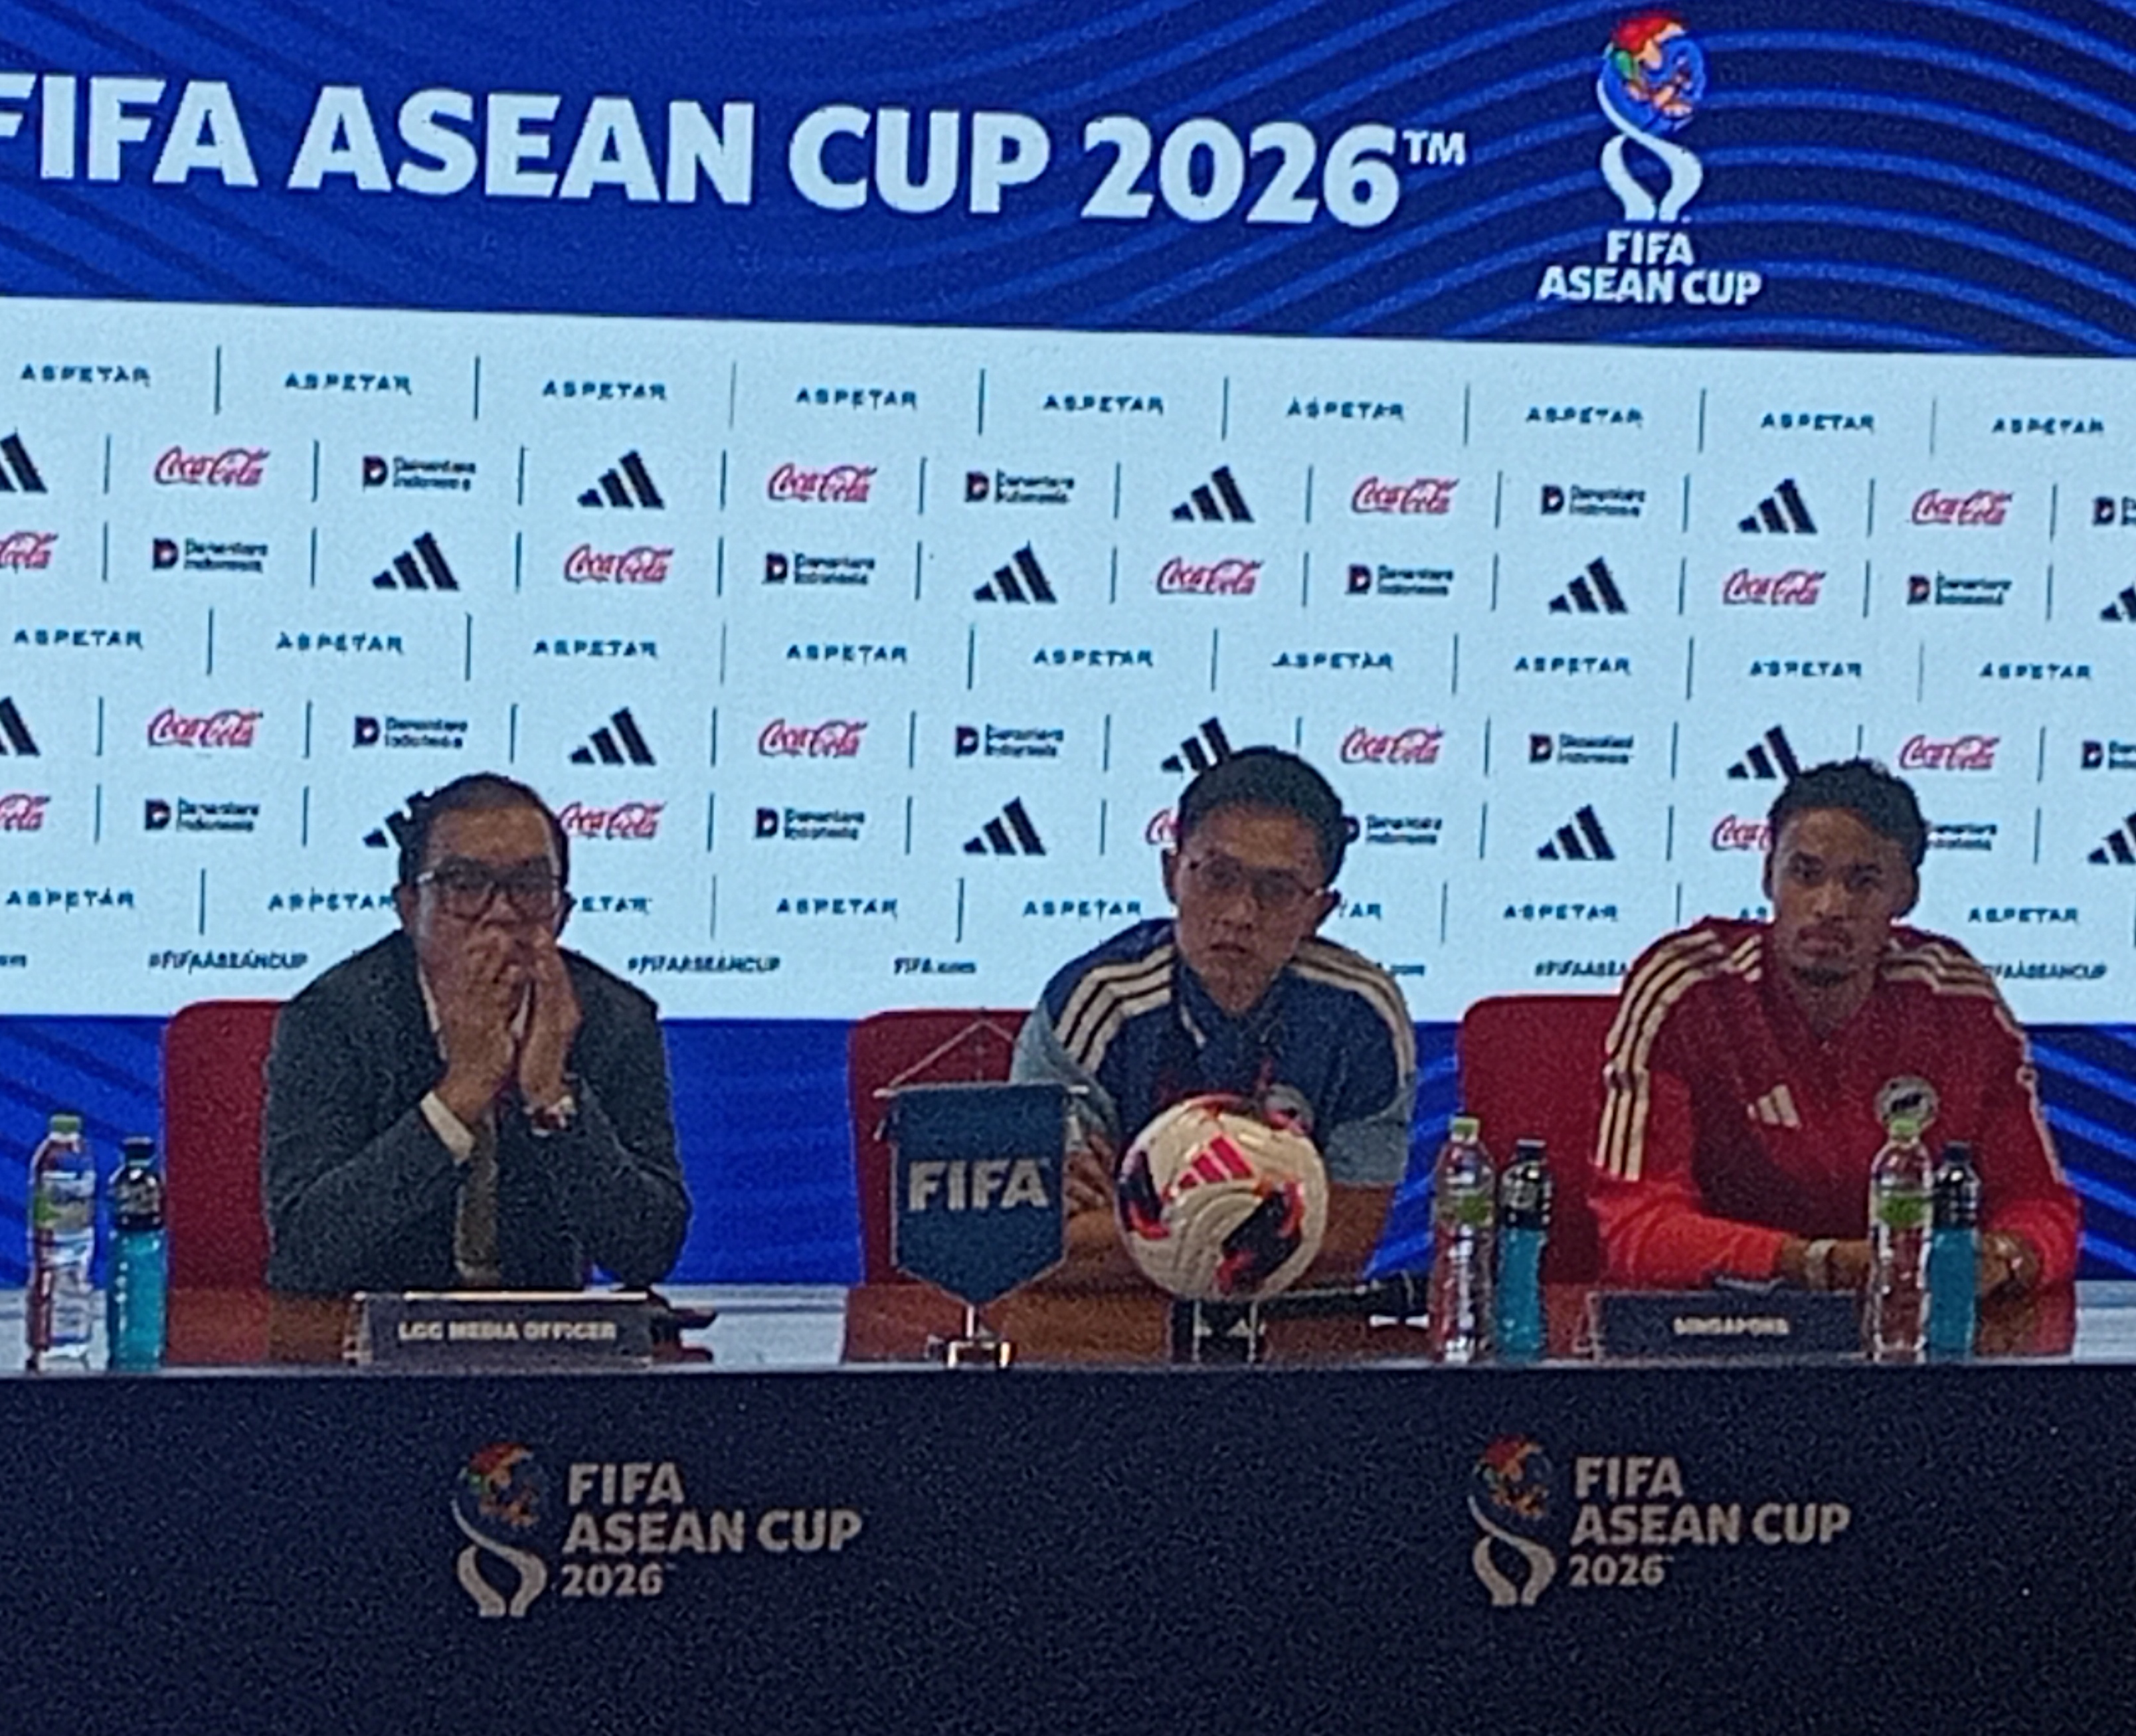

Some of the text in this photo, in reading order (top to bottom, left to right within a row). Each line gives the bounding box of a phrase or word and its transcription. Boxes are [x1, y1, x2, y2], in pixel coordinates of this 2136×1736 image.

[286, 84, 754, 205] ASEAN
[788, 104, 1050, 215] CUP
[1606, 229, 1694, 266] FIFA
[1536, 265, 1762, 305] ASEAN CUP
[581, 895, 652, 914] ETAR
[908, 1158, 1049, 1212] FIFA
[569, 1462, 685, 1505] FIFA
[1575, 1456, 1684, 1498] FIFA
[562, 1508, 862, 1555] ASEAN CUP
[1570, 1502, 1851, 1547] ASEAN CUP
